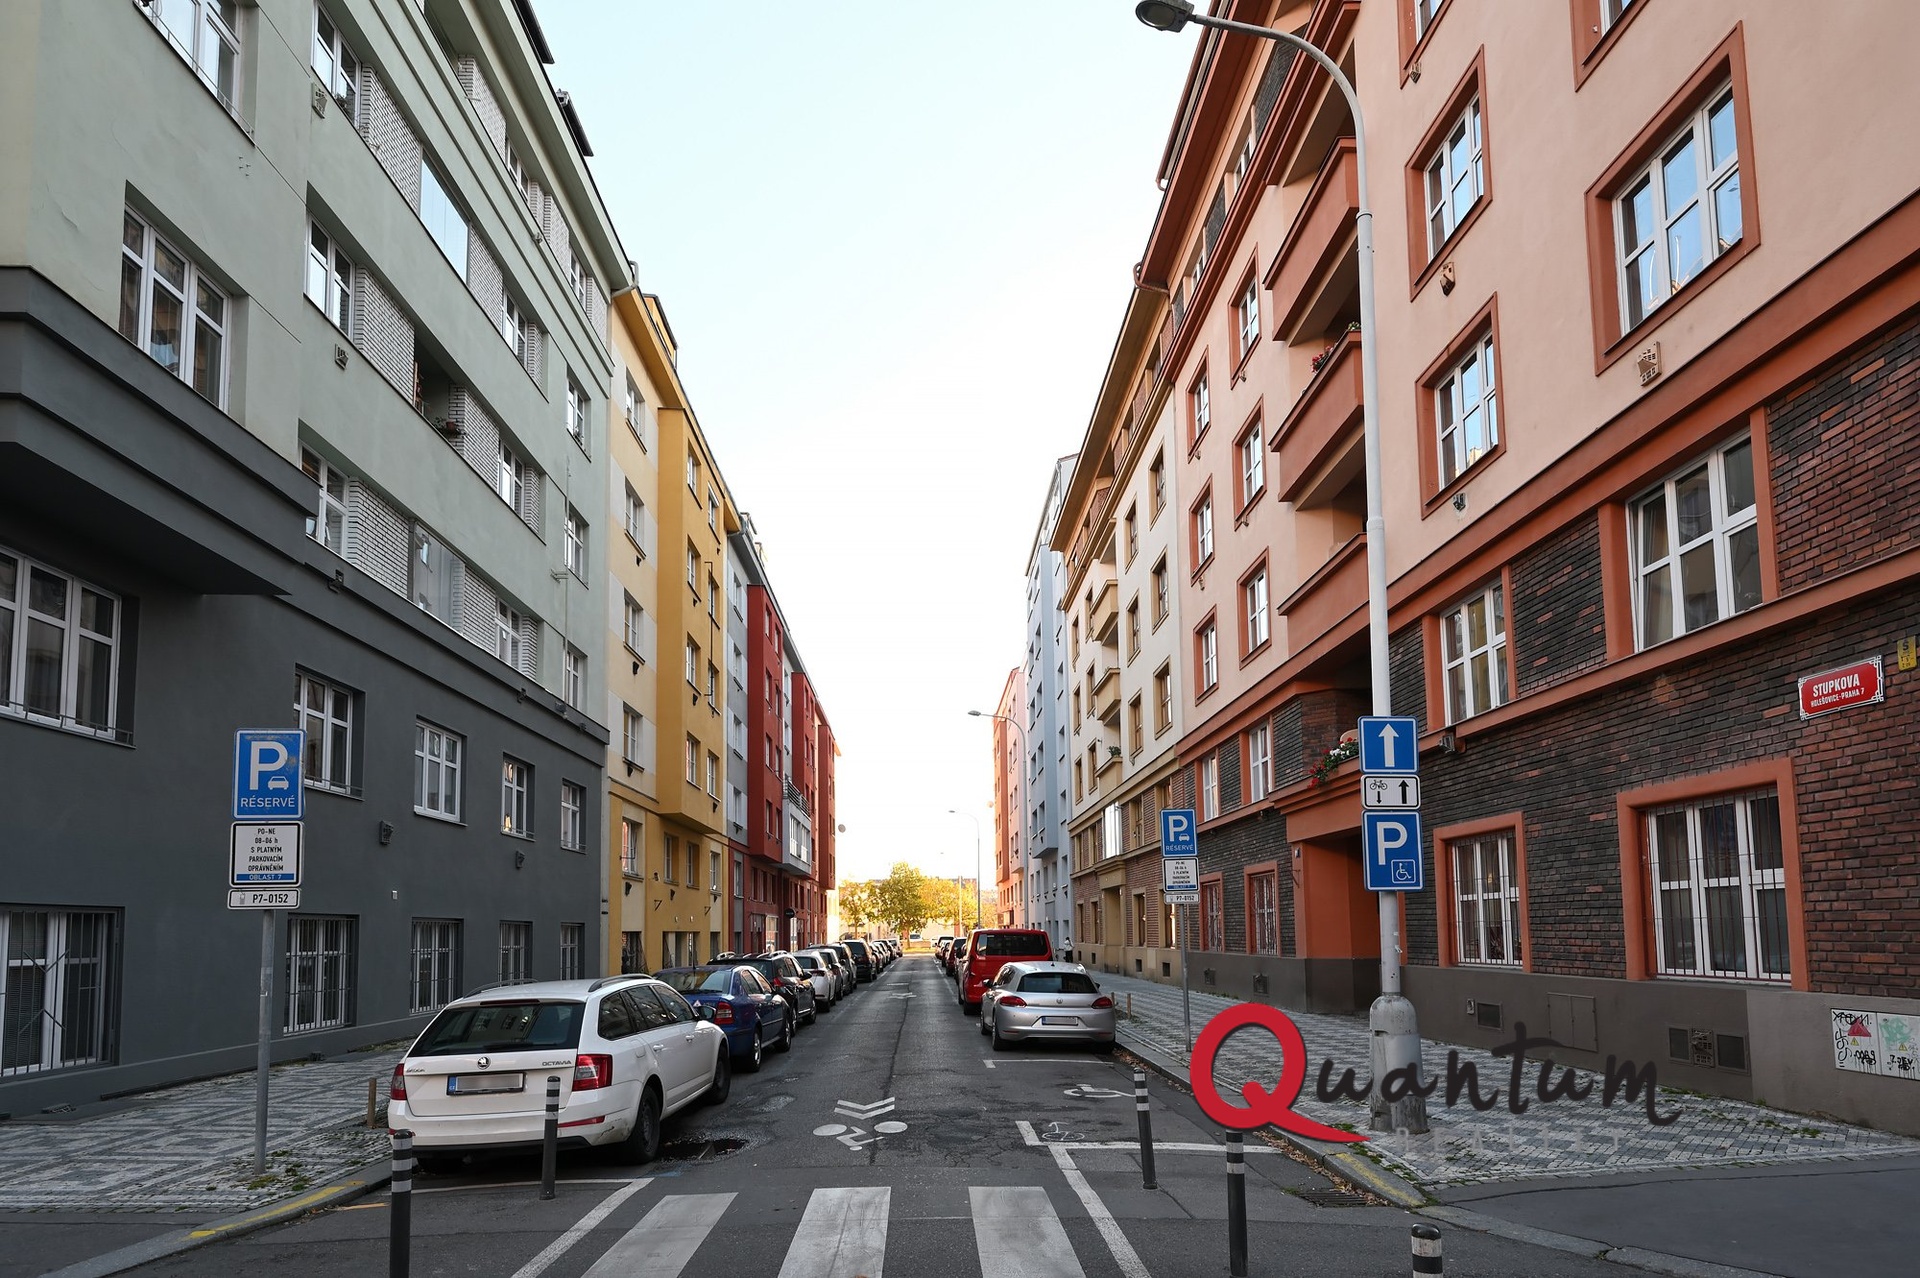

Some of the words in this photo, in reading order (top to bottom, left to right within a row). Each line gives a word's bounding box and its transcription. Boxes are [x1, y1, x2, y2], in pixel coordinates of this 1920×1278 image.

[1812, 673, 1860, 698] STUPKOVA
[1860, 687, 1865, 695] 7
[249, 741, 288, 790] P
[240, 795, 296, 808] RÉSERVÉ
[1168, 815, 1188, 842] P
[256, 845, 282, 853] PLATNÝM
[1376, 822, 1408, 866] P
[248, 854, 283, 862] PARKOVACÍM
[252, 893, 289, 904] P7-0152
